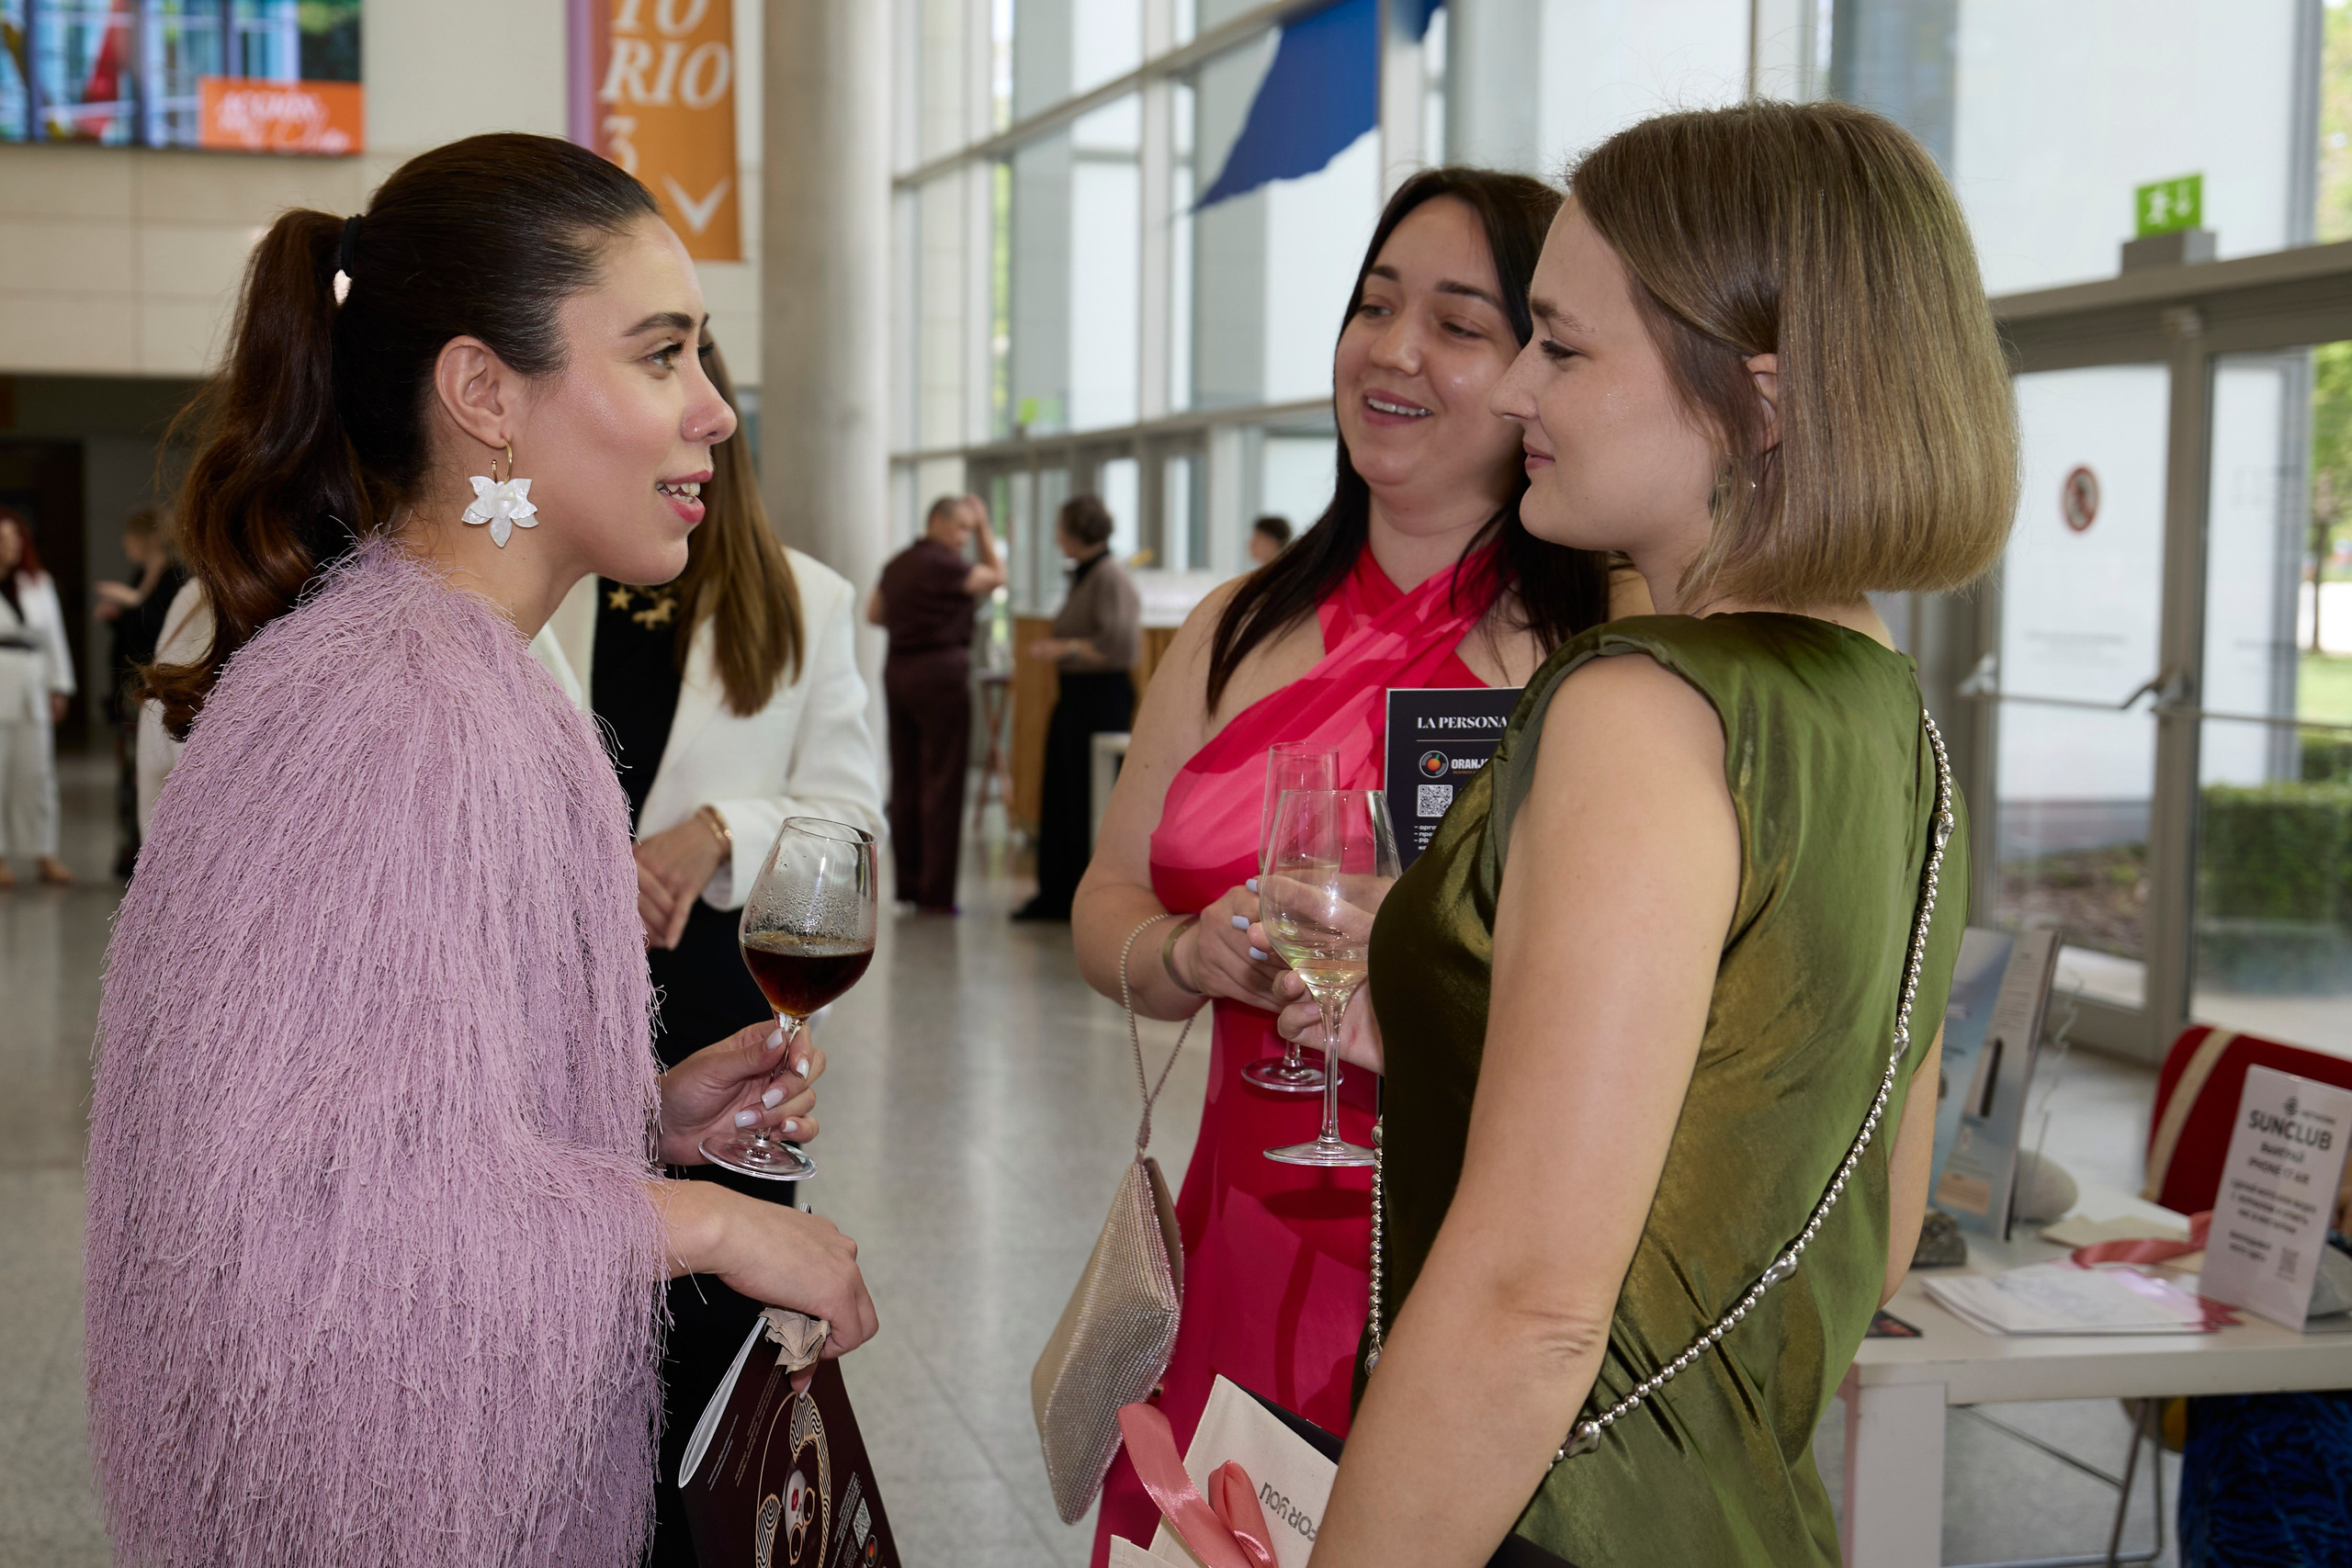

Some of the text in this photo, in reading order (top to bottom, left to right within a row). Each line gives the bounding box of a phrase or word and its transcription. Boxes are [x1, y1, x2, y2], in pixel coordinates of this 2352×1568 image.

[597, 37, 732, 110] RIO
[1417, 716, 1508, 728] LA PERSONA
[1452, 758, 1488, 770] ORANJ
[2248, 1109, 2334, 1151] SUNCLUB
